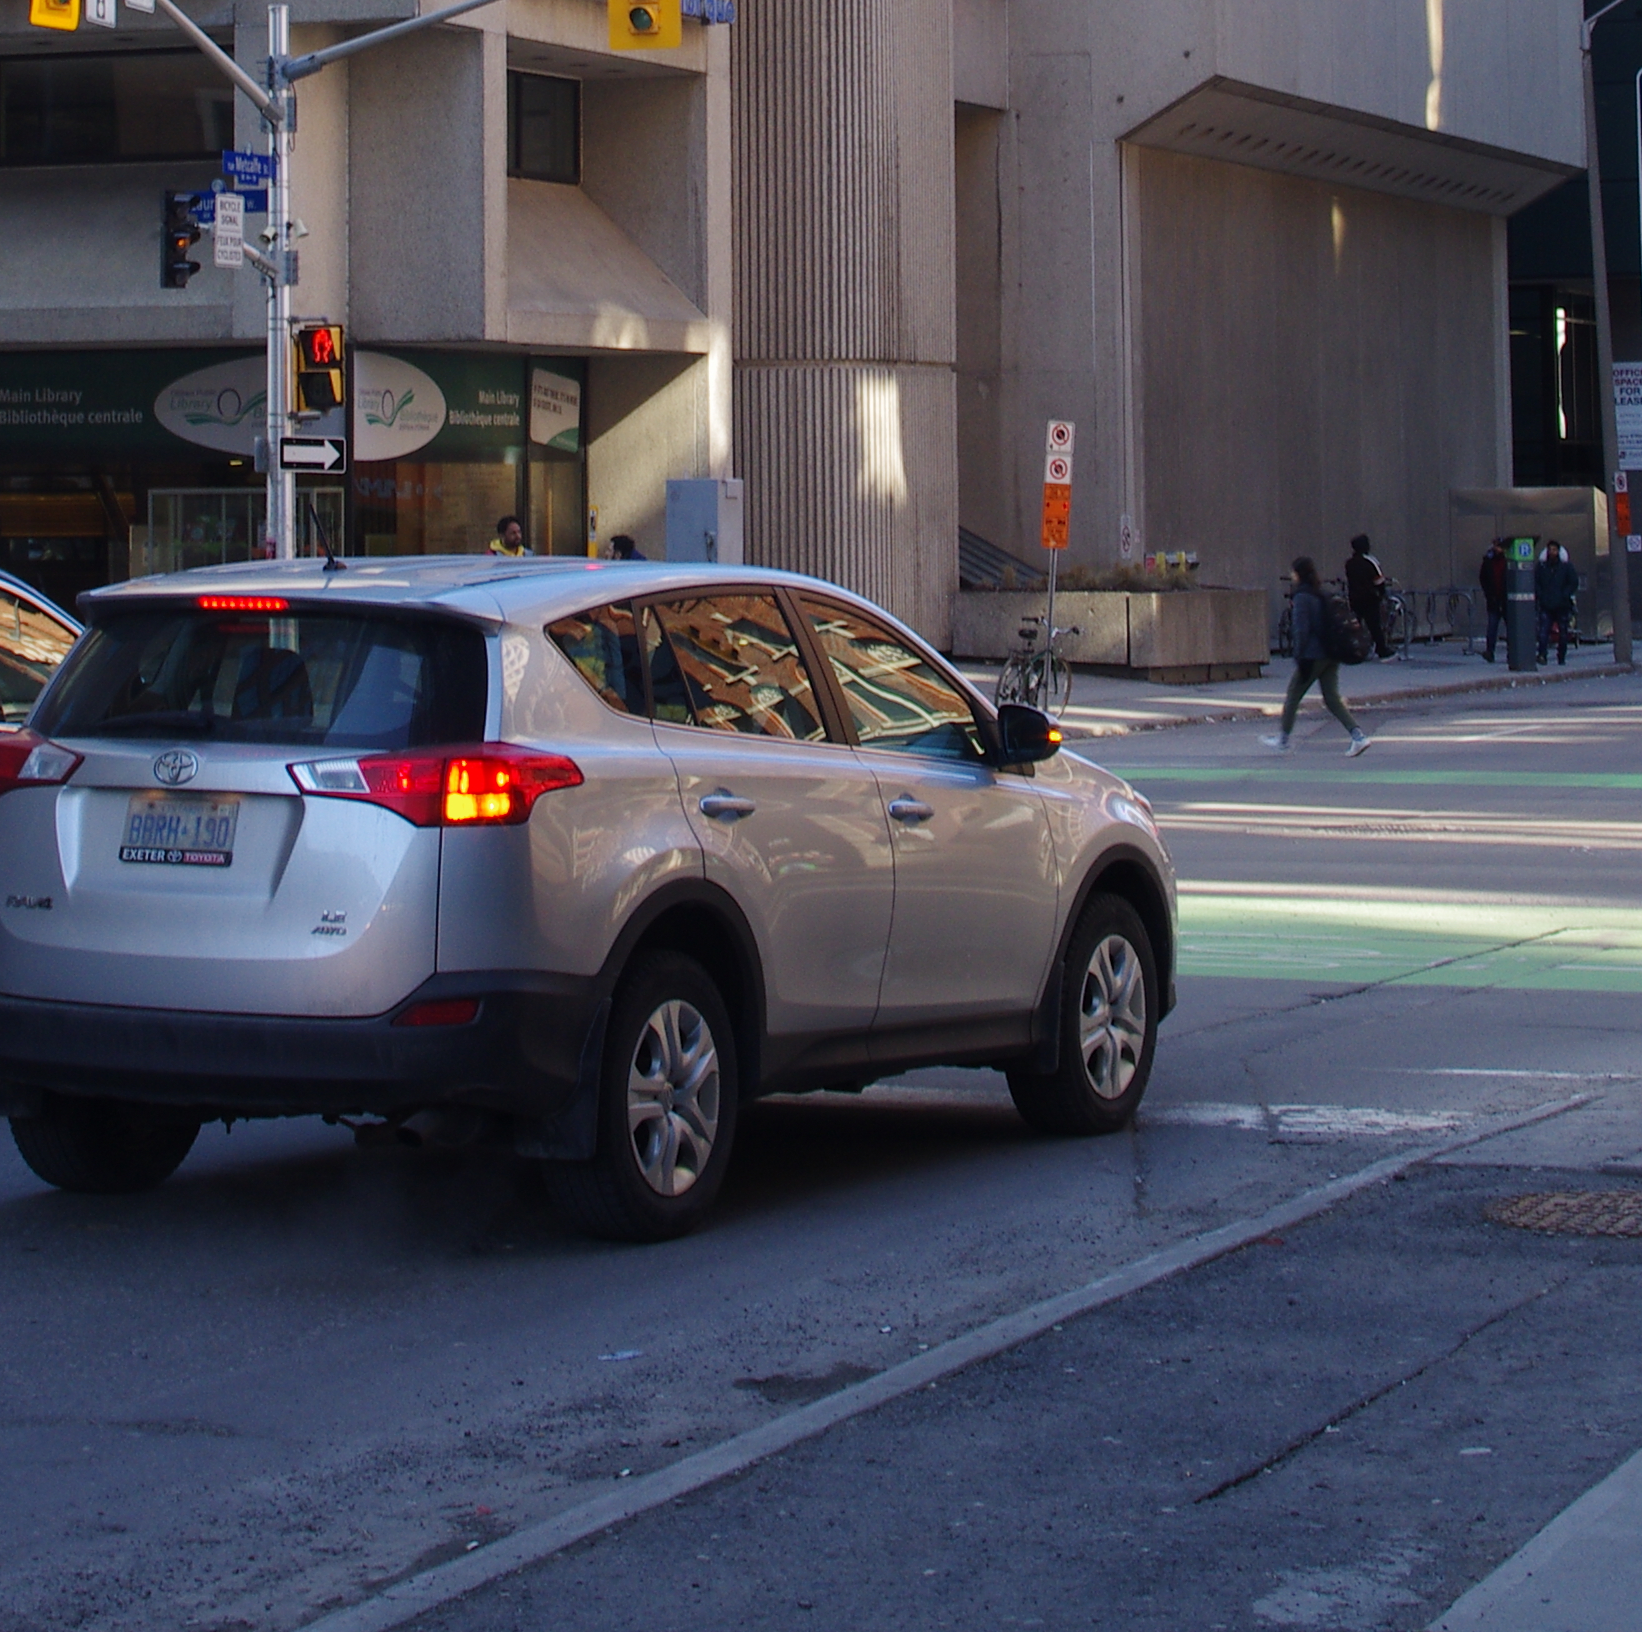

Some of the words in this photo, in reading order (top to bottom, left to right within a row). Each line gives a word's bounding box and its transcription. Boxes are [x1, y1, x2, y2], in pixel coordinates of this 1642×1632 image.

[235, 155, 262, 174] Metcalfe
[219, 199, 241, 213] BICYCLE
[221, 214, 239, 226] SIGNAL
[34, 387, 83, 406] Library
[478, 389, 496, 405] Main
[496, 390, 521, 409] Library
[1619, 387, 1641, 396] FOR
[87, 407, 143, 424] centrale
[448, 409, 493, 429] Bibliothèque
[494, 411, 521, 427] centrale
[122, 848, 166, 861] EXETER
[184, 852, 225, 864] TOYOTA
